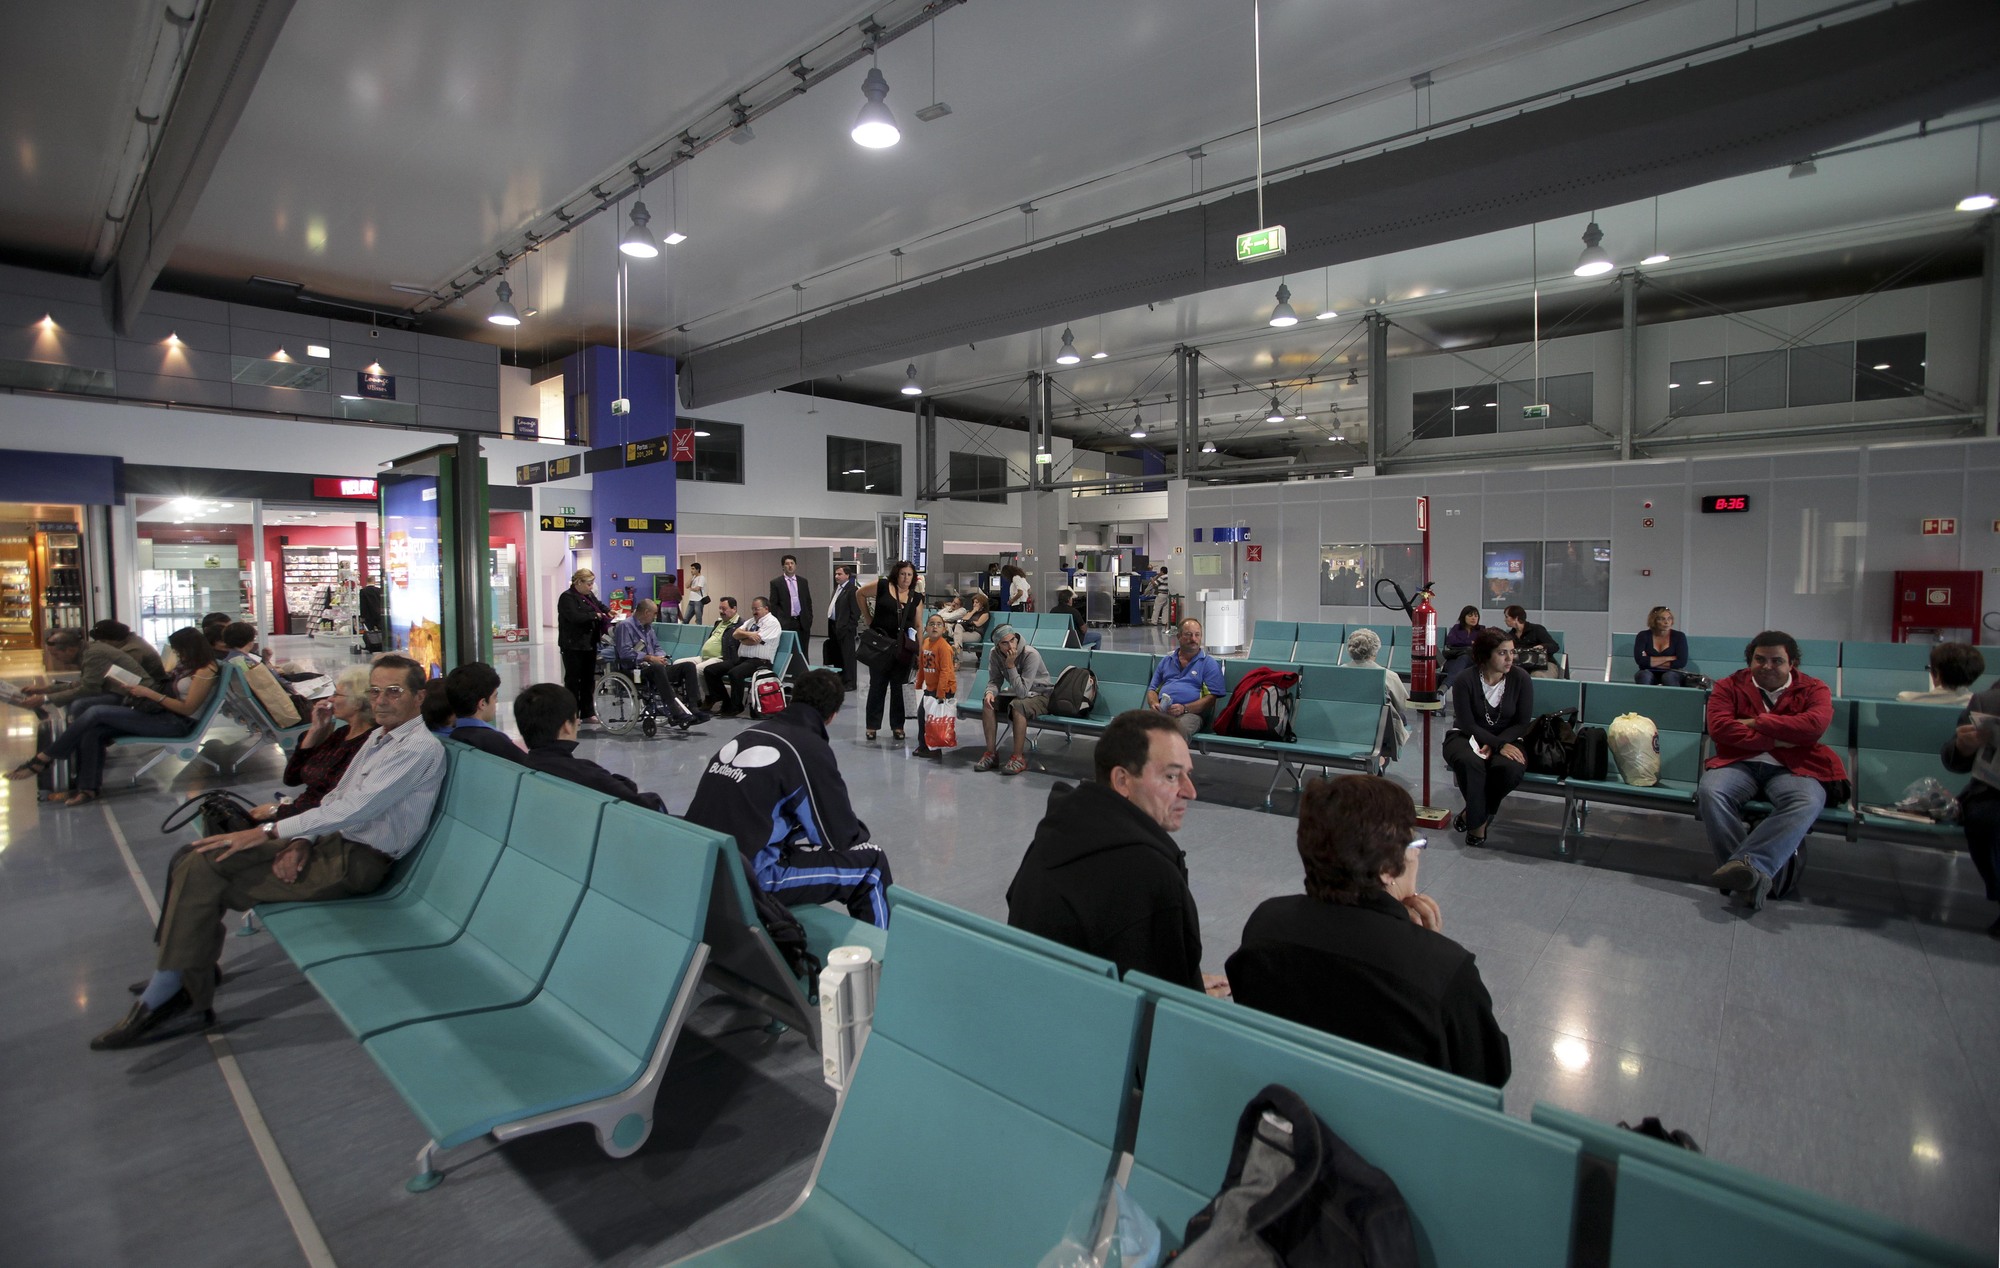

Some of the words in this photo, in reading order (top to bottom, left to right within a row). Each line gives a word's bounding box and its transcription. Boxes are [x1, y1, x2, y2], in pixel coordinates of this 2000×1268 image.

[517, 419, 536, 428] Lounge
[1715, 498, 1745, 510] 8:36
[927, 714, 955, 724] Bata
[708, 762, 747, 783] Butterfly
